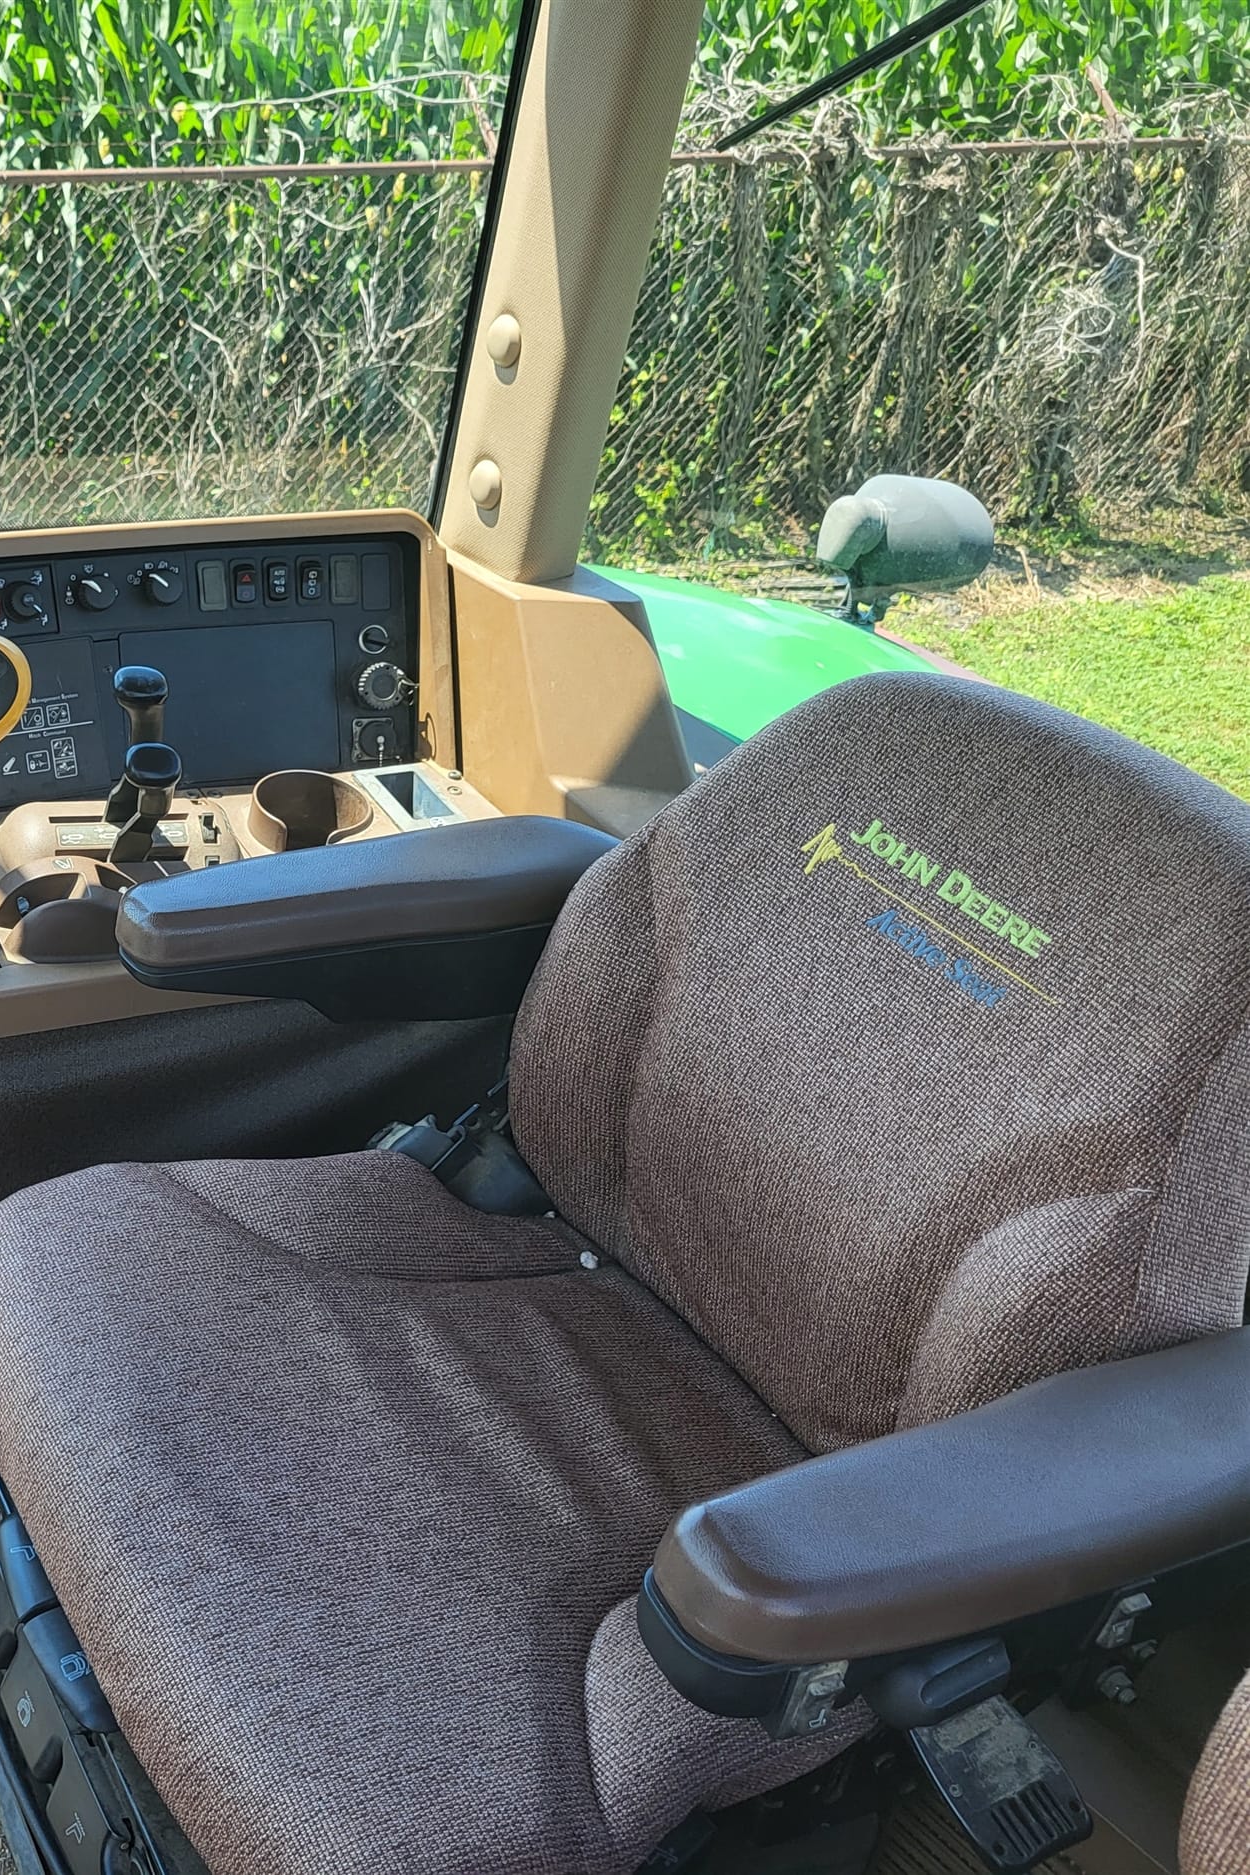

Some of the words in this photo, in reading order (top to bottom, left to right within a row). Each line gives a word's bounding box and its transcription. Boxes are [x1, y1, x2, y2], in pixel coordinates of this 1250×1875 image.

[850, 818, 941, 887] JOHN
[936, 869, 1051, 959] DEERE
[865, 909, 947, 968] Active
[944, 957, 1007, 1008] Seat
